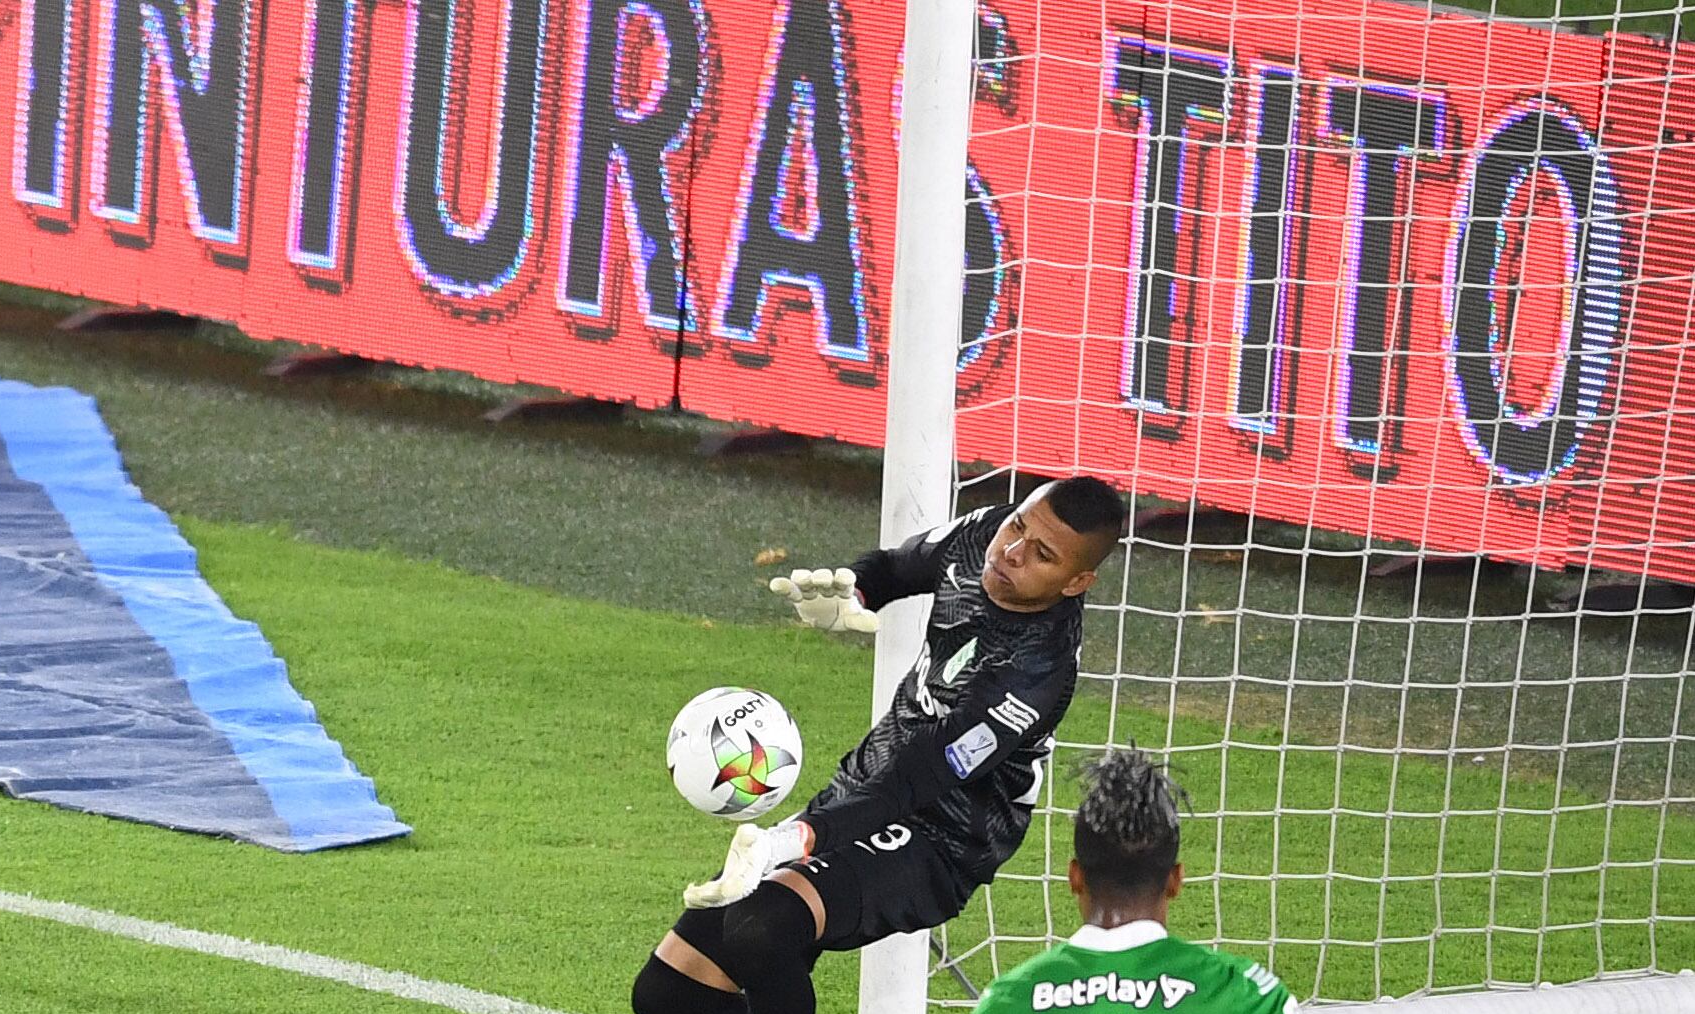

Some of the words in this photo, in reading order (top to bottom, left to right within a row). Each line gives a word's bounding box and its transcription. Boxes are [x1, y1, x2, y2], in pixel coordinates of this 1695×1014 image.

[1106, 28, 1624, 487] TITO
[724, 698, 765, 727] GOLTY
[1033, 972, 1157, 1009] BetPlay
